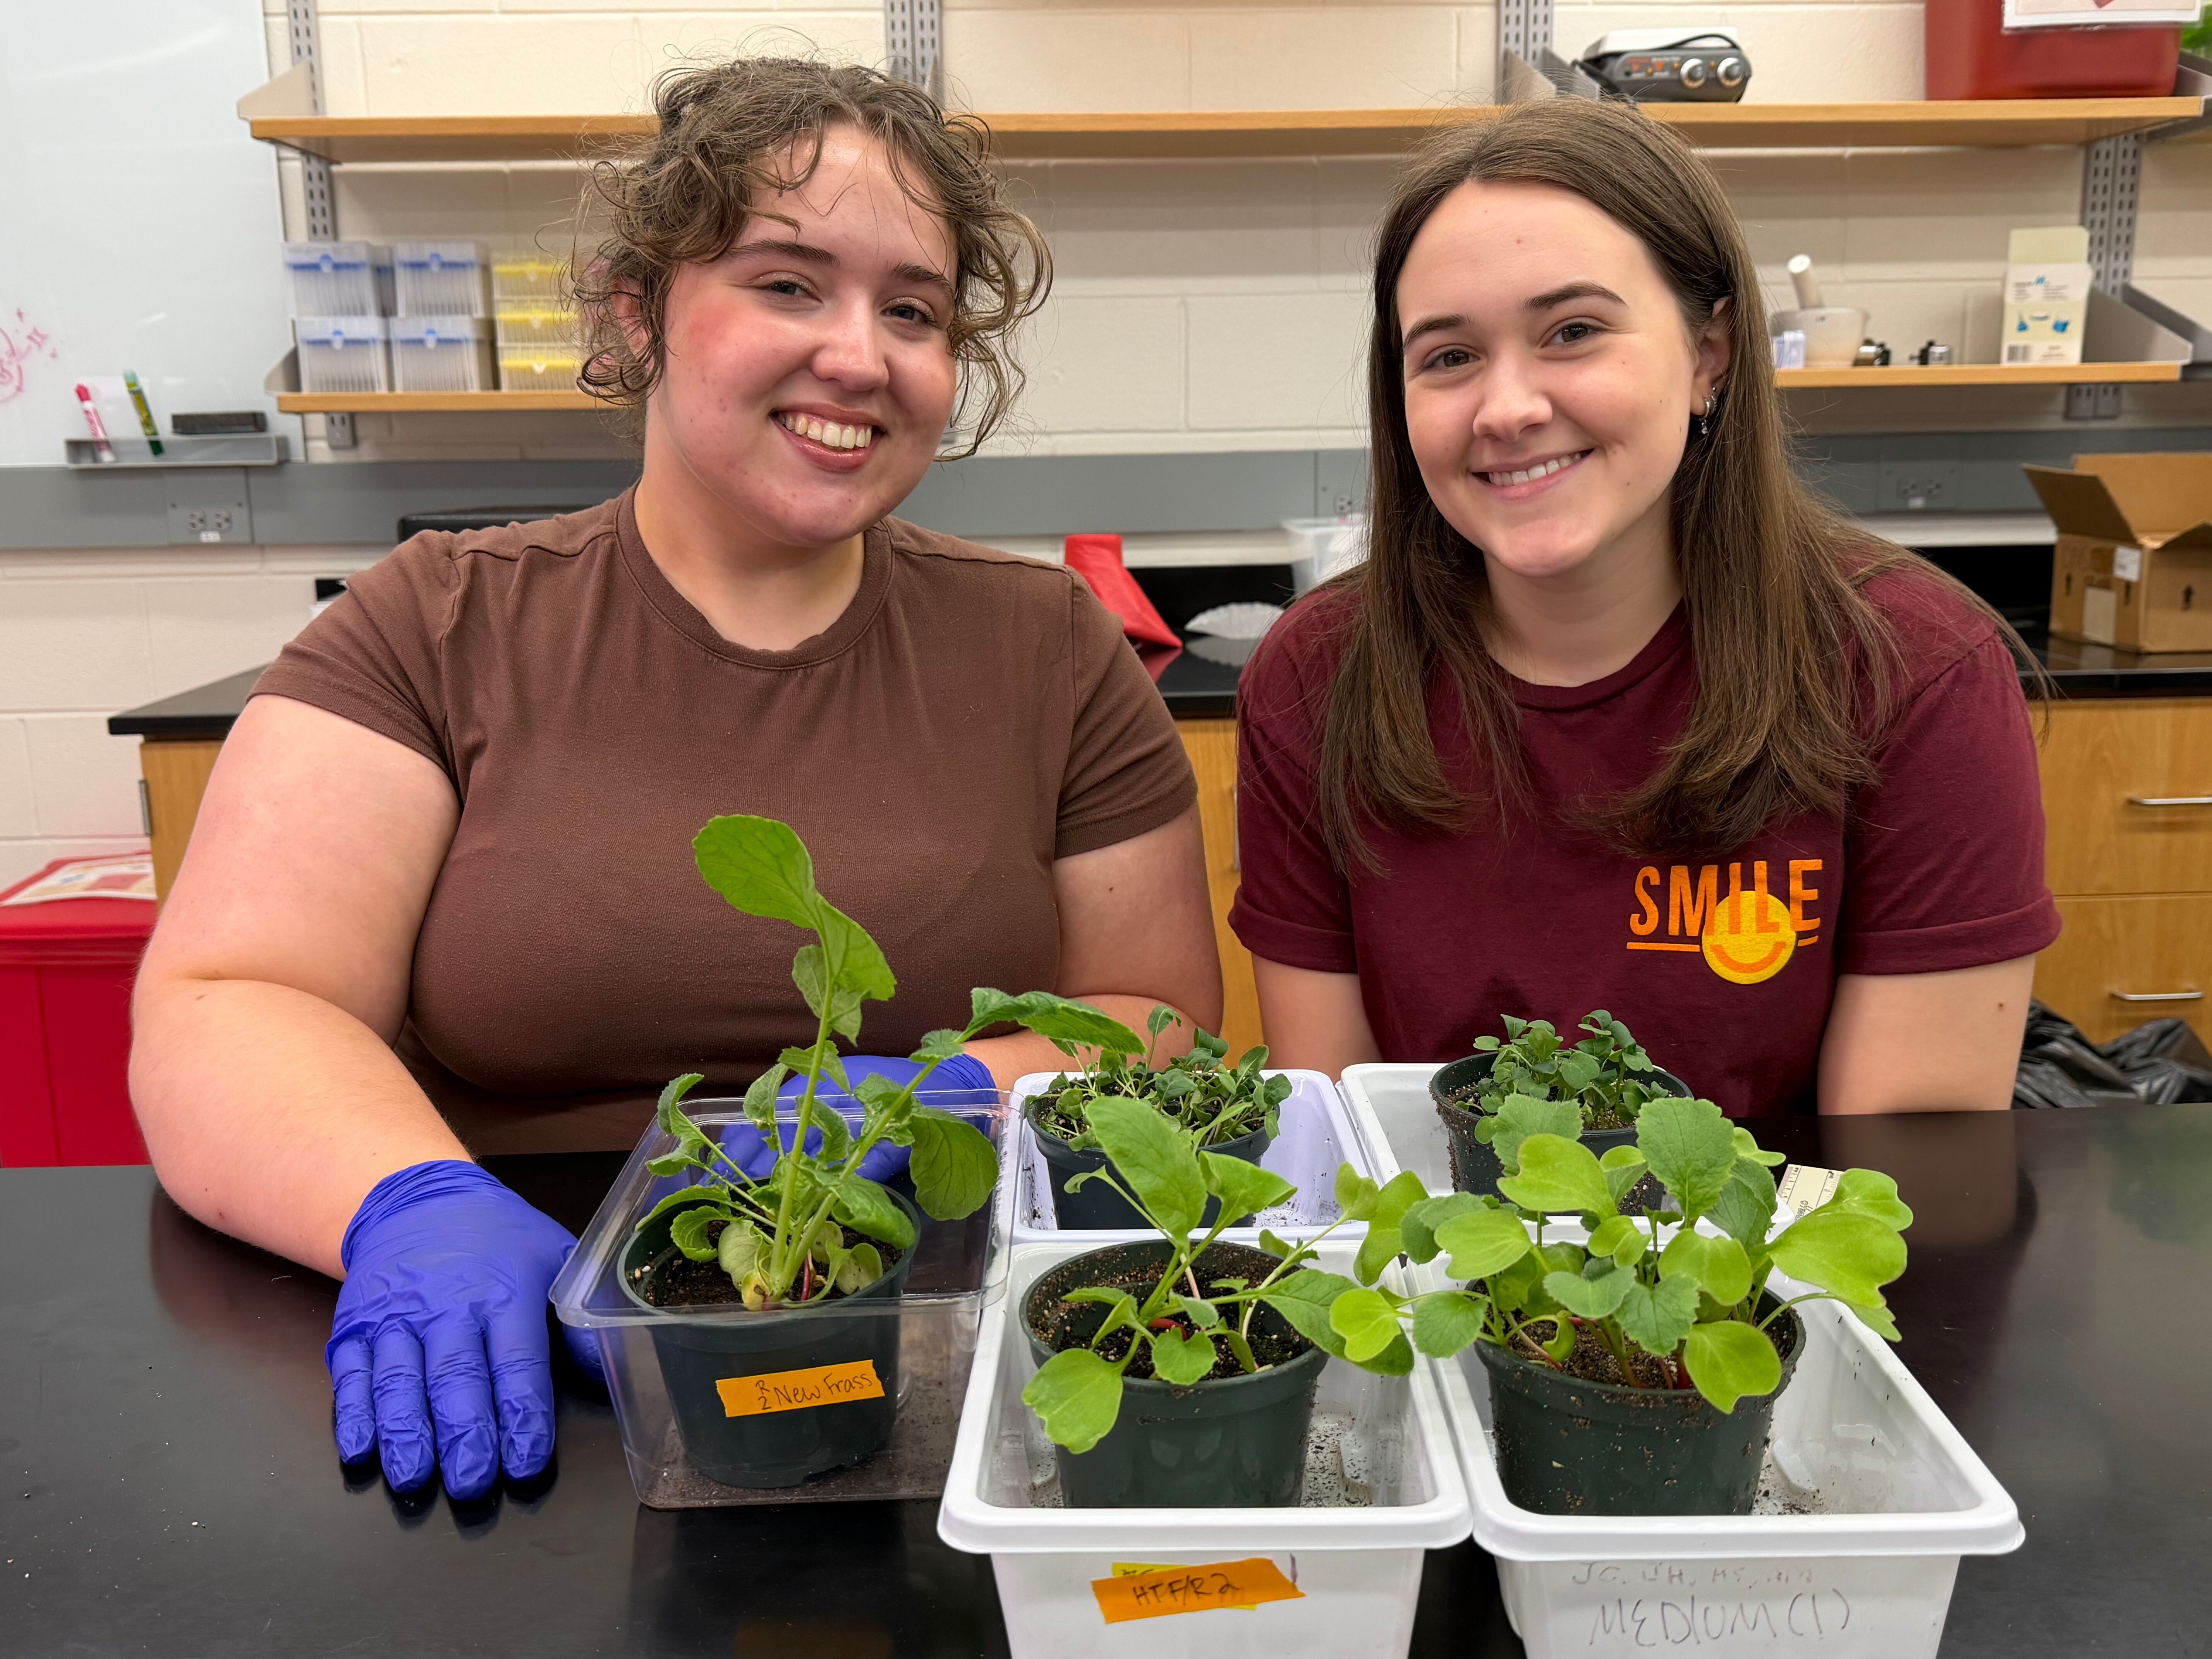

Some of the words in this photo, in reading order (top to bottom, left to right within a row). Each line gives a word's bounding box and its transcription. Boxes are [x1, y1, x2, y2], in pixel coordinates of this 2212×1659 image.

[1630, 859, 1822, 936] SMILE
[756, 1379, 770, 1395] R
[757, 1396, 772, 1410] 2
[774, 1385, 821, 1406] New
[823, 1372, 872, 1395] Frass
